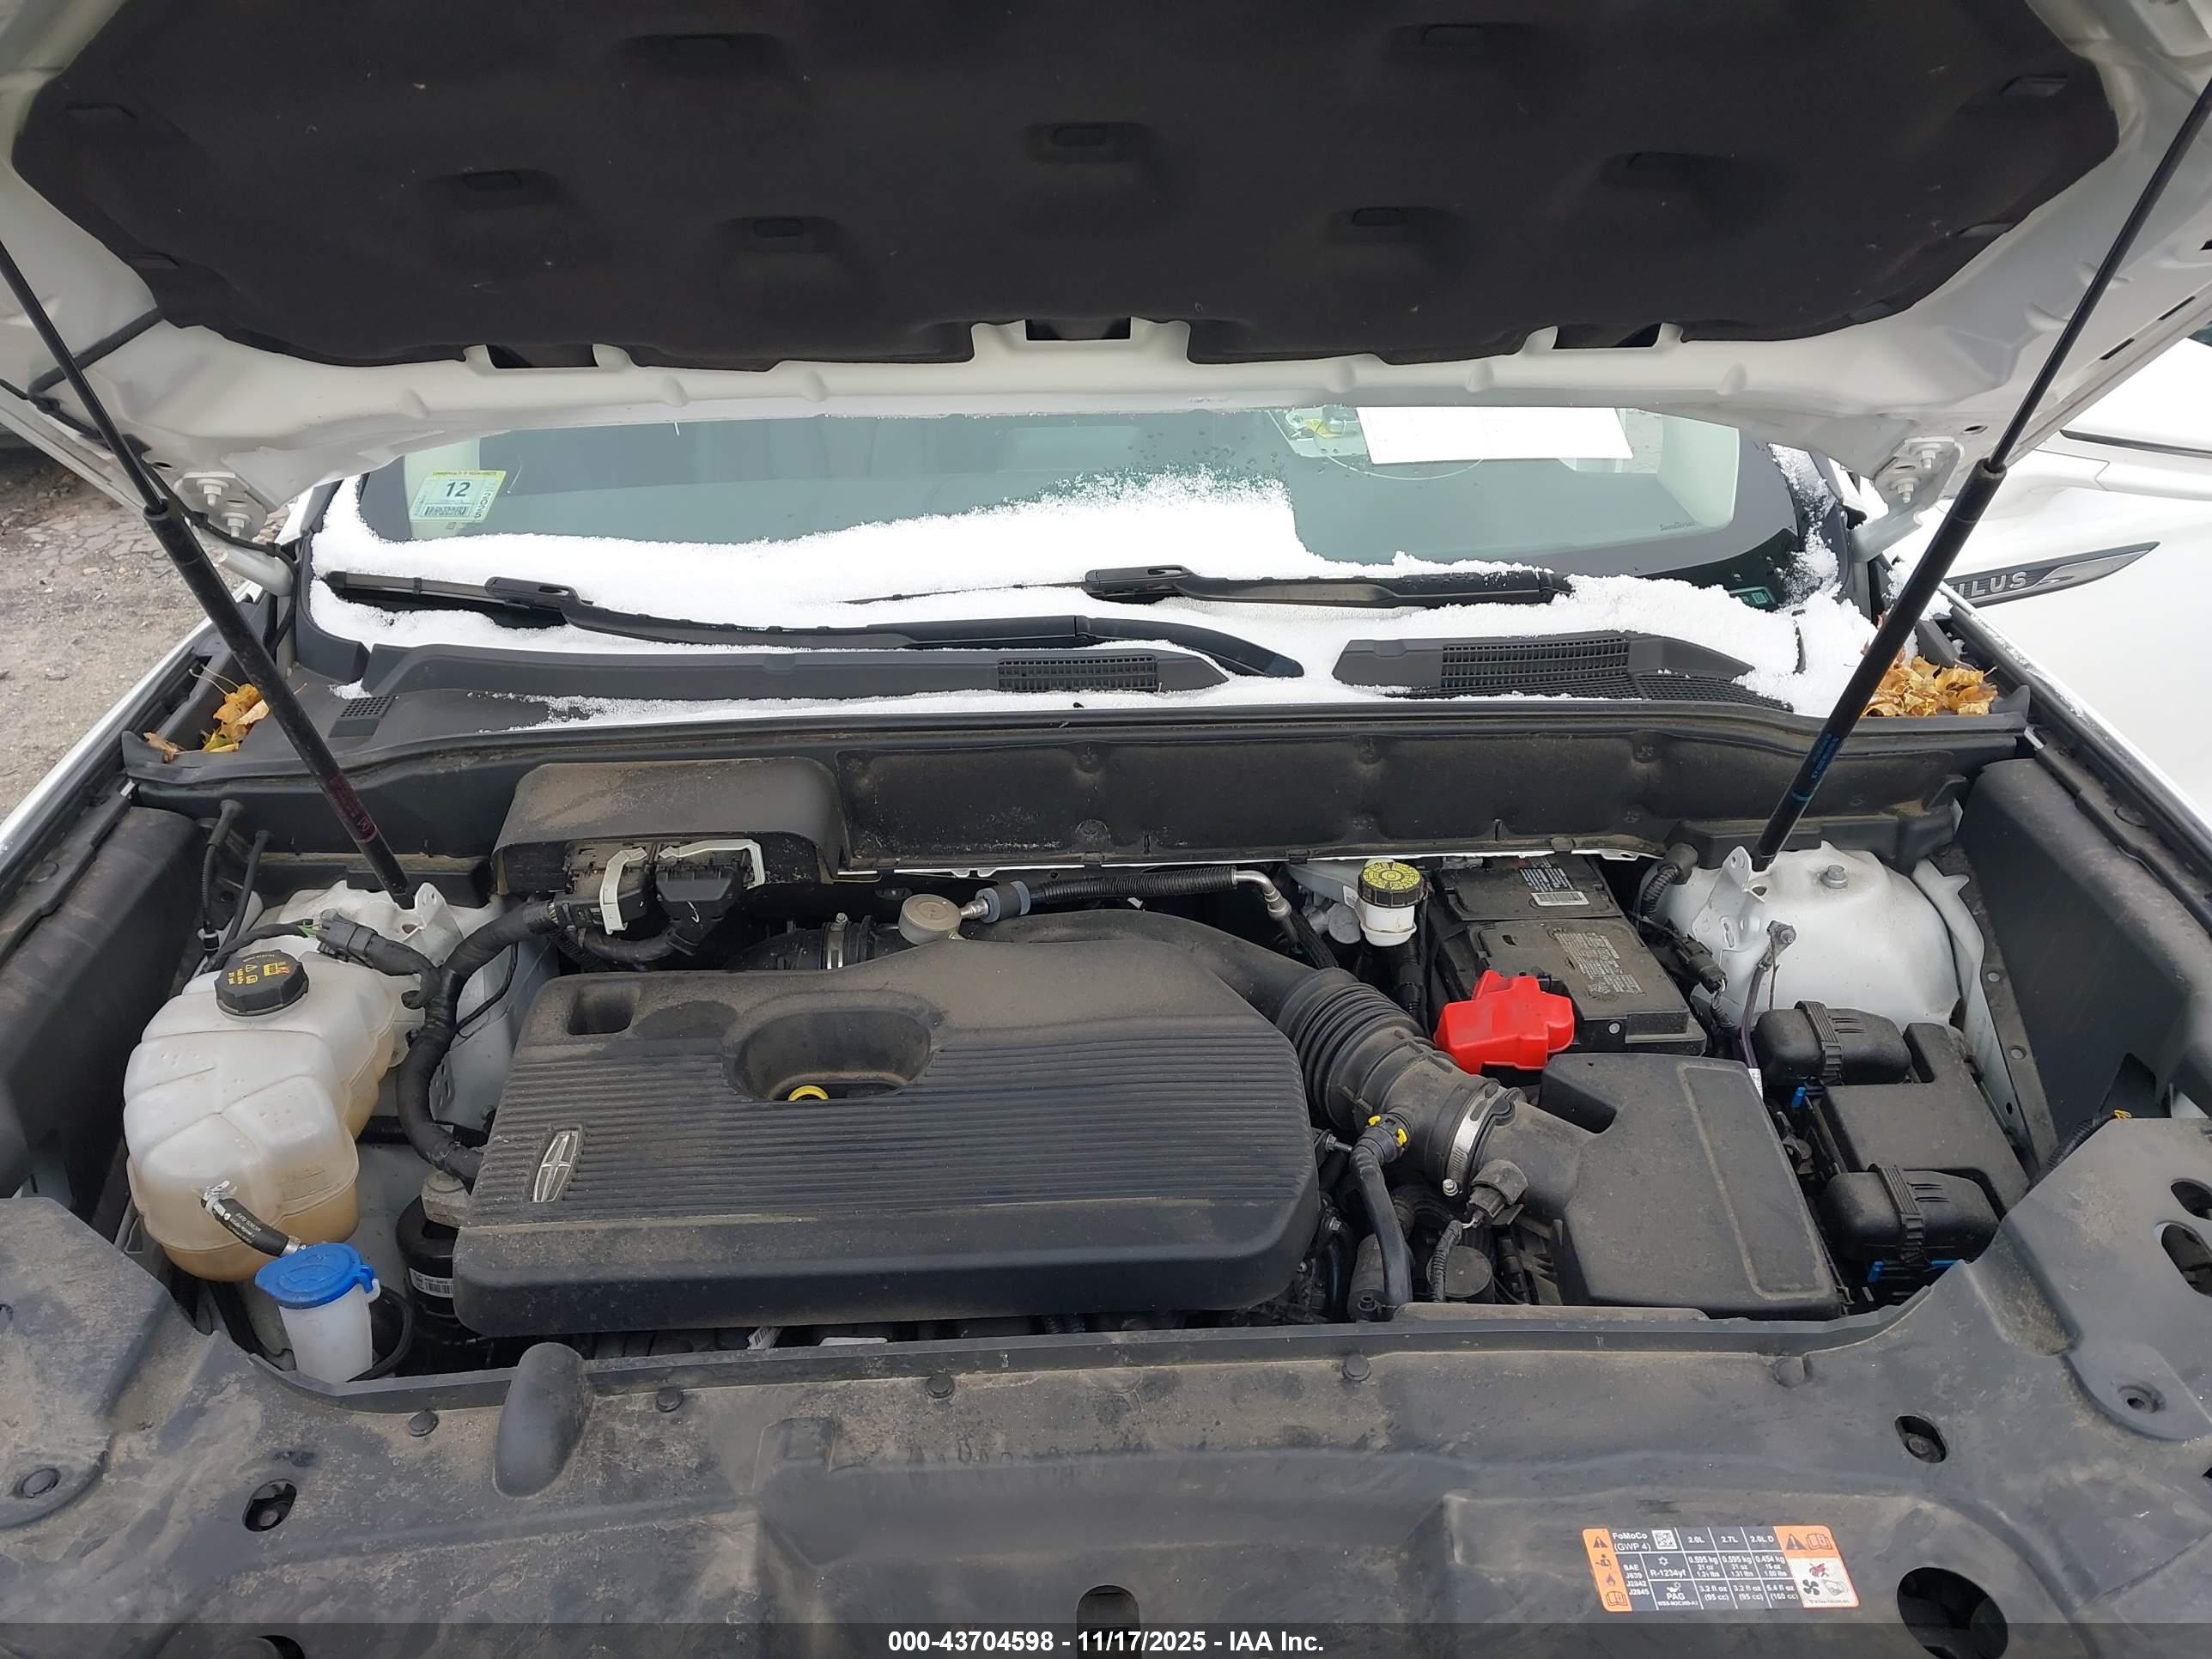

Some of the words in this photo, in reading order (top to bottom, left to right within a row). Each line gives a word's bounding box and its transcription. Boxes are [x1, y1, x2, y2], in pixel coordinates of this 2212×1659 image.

[446, 482, 471, 497] 12
[1949, 571, 2027, 597] ILUS
[1614, 1543, 1639, 1552] (GWP
